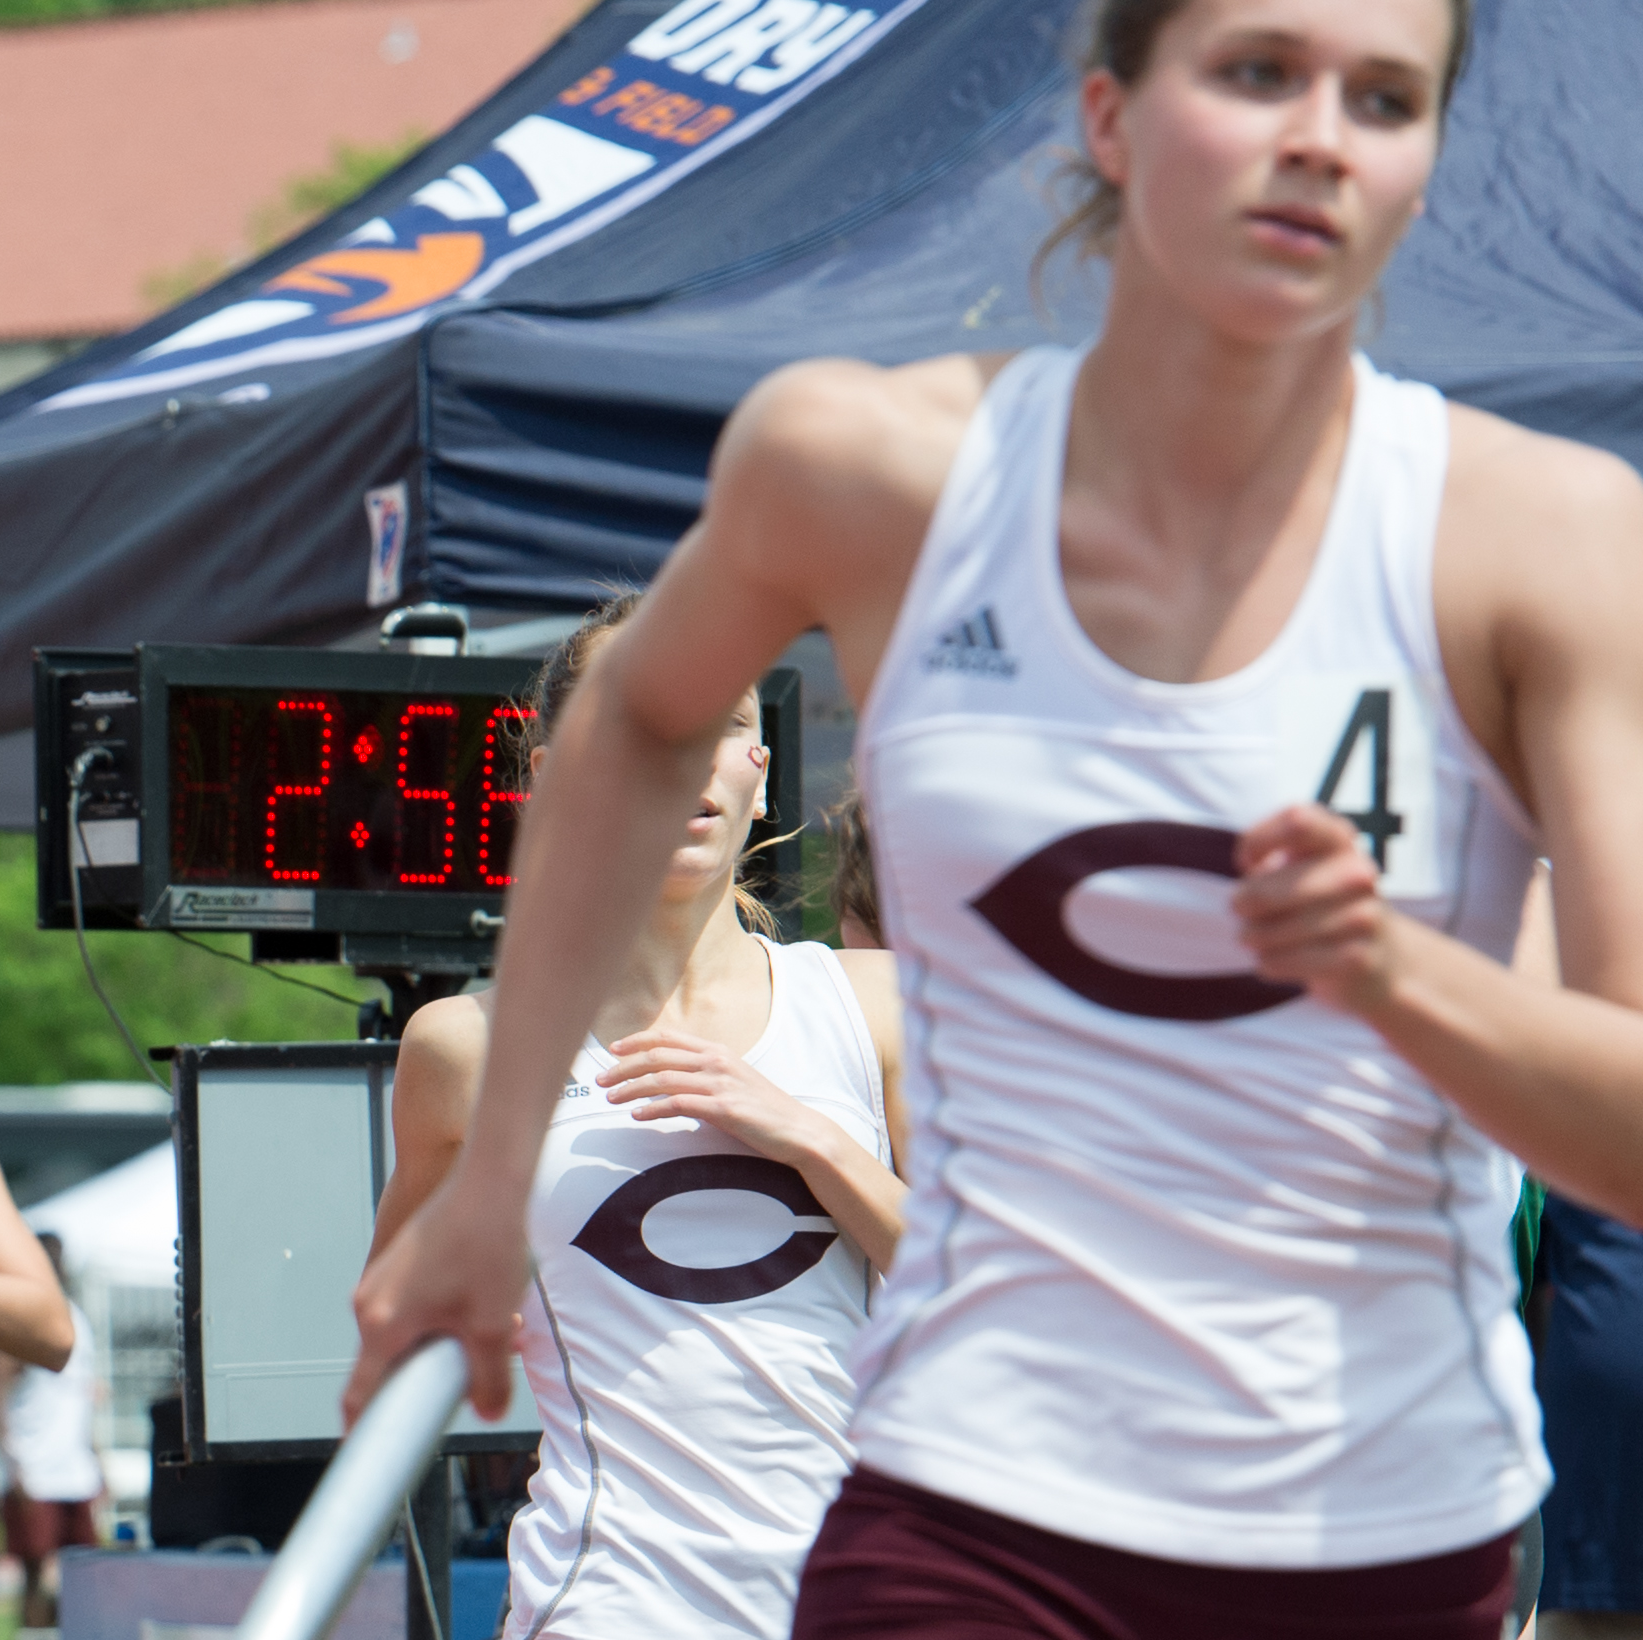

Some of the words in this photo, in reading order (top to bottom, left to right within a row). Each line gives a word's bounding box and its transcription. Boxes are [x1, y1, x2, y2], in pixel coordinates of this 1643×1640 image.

[591, 79, 737, 147] FIELD
[1320, 691, 1402, 872] 4
[570, 1153, 841, 1304] C
